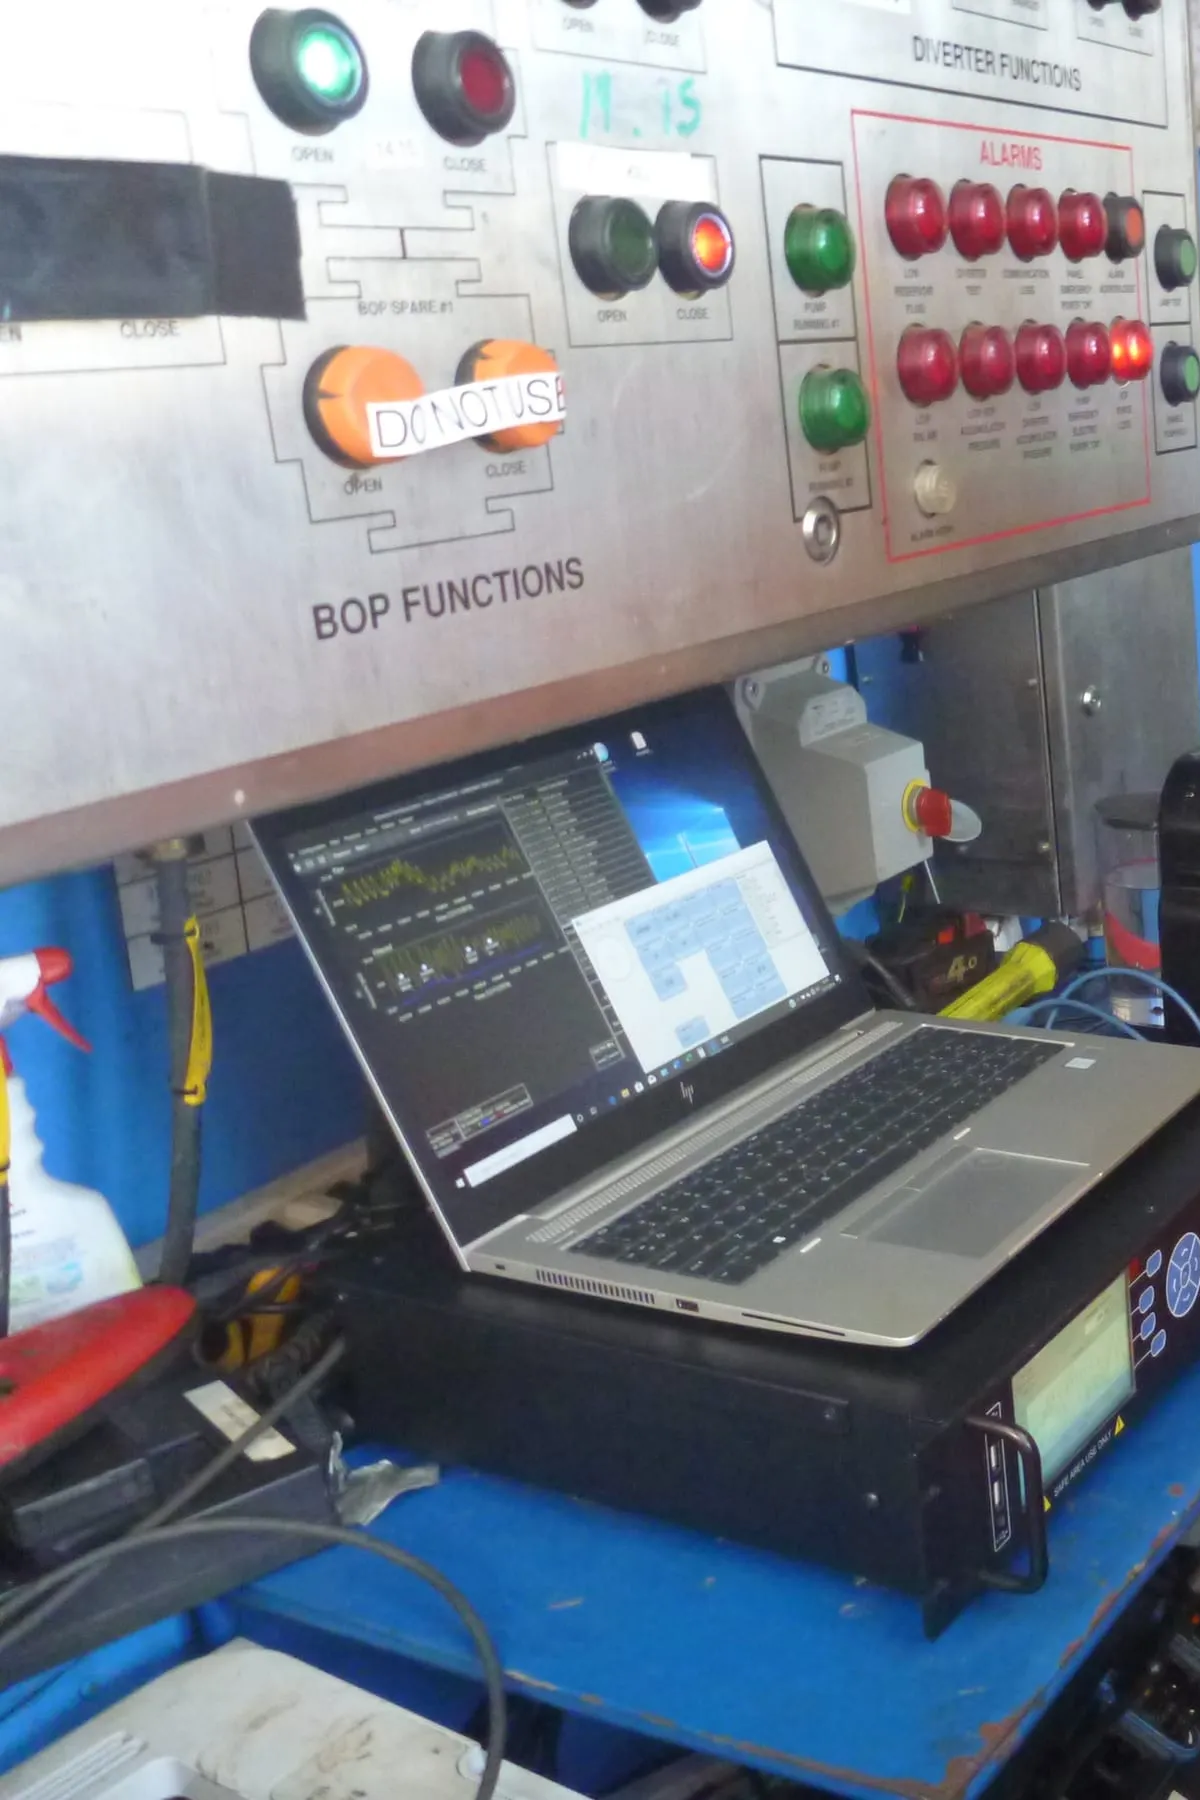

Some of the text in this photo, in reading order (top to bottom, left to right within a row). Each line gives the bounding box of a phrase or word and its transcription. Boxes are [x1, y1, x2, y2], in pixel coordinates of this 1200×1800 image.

[913, 35, 1081, 91] DIVERTER FUNCTIONS
[292, 146, 335, 163] OPEN
[980, 141, 1043, 171] ALARMS
[443, 156, 487, 172] CLOSE
[358, 300, 453, 316] BOP SPARE #1
[597, 309, 627, 323] OPEN
[676, 307, 710, 321] CLOSE
[120, 320, 180, 338] CLOSE
[375, 403, 428, 448] DO
[430, 385, 502, 434] NOT
[485, 461, 526, 478] CLOSE
[344, 477, 382, 495] OPEN
[312, 557, 584, 640] BOP FUNCTIONS
